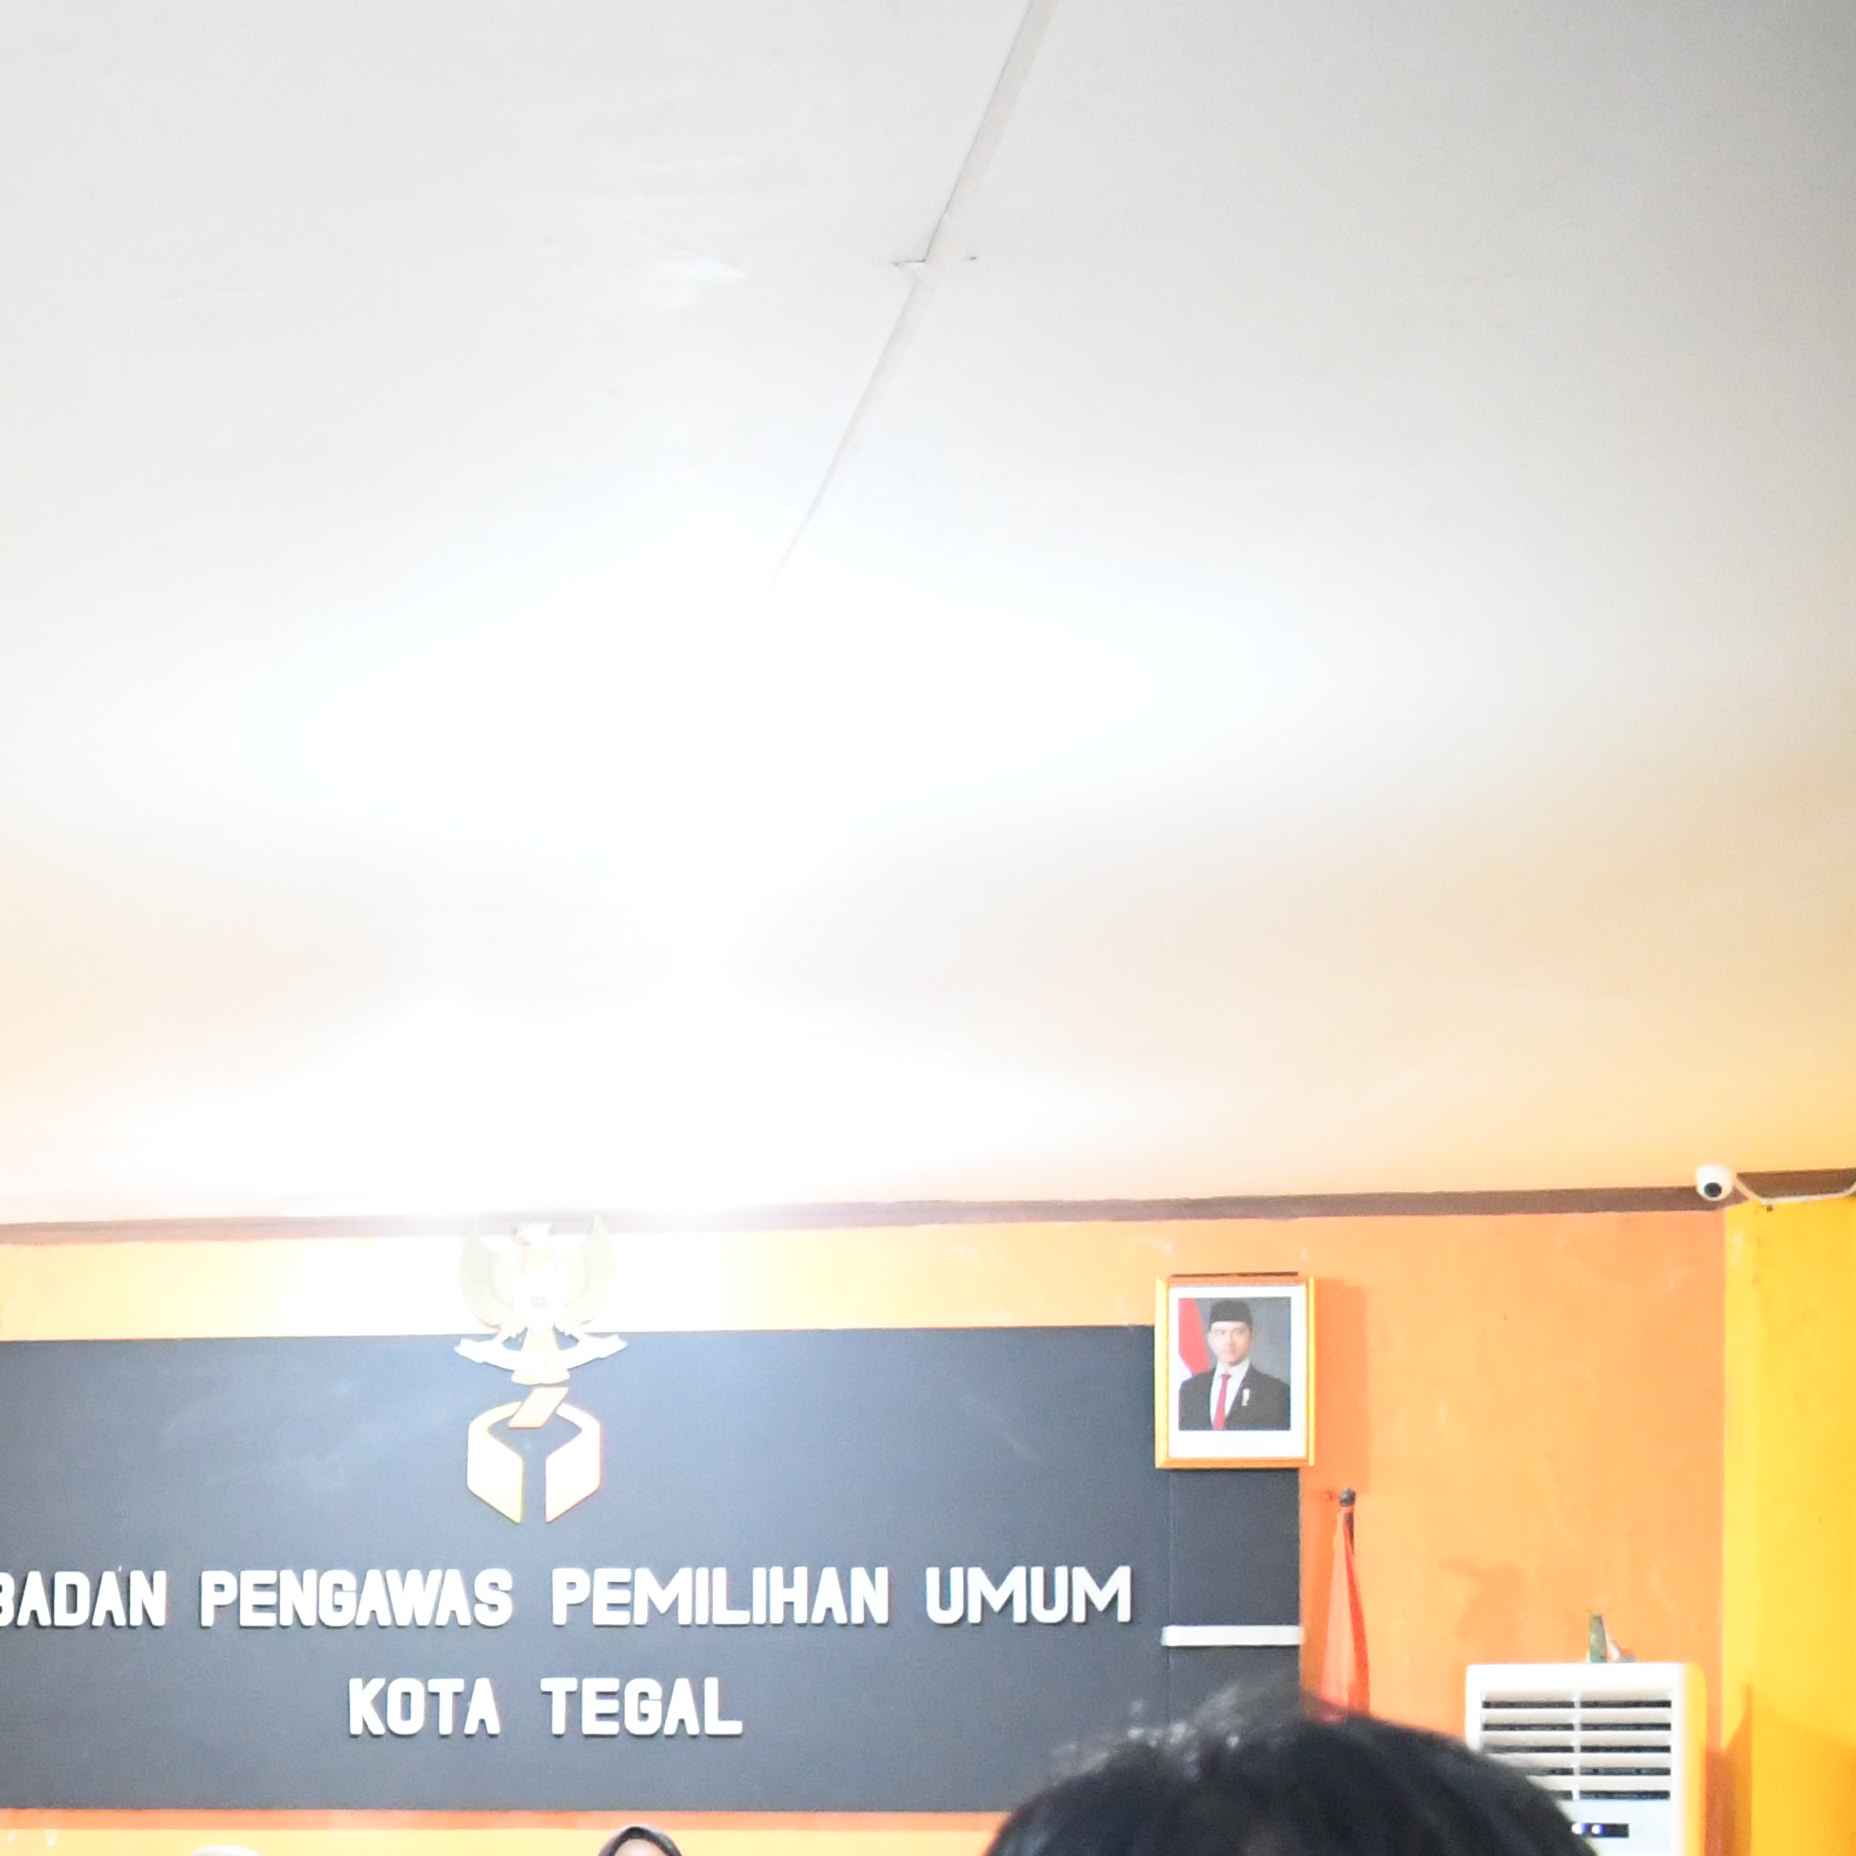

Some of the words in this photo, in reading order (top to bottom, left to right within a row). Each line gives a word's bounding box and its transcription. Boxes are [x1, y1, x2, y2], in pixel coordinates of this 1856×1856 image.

[200, 1566, 514, 1627] PENGAWAS
[551, 1565, 890, 1626] PEMILIHAN
[926, 1564, 1133, 1625] UMUM
[348, 1677, 501, 1737] KOTA
[539, 1676, 744, 1737] TEGAL
